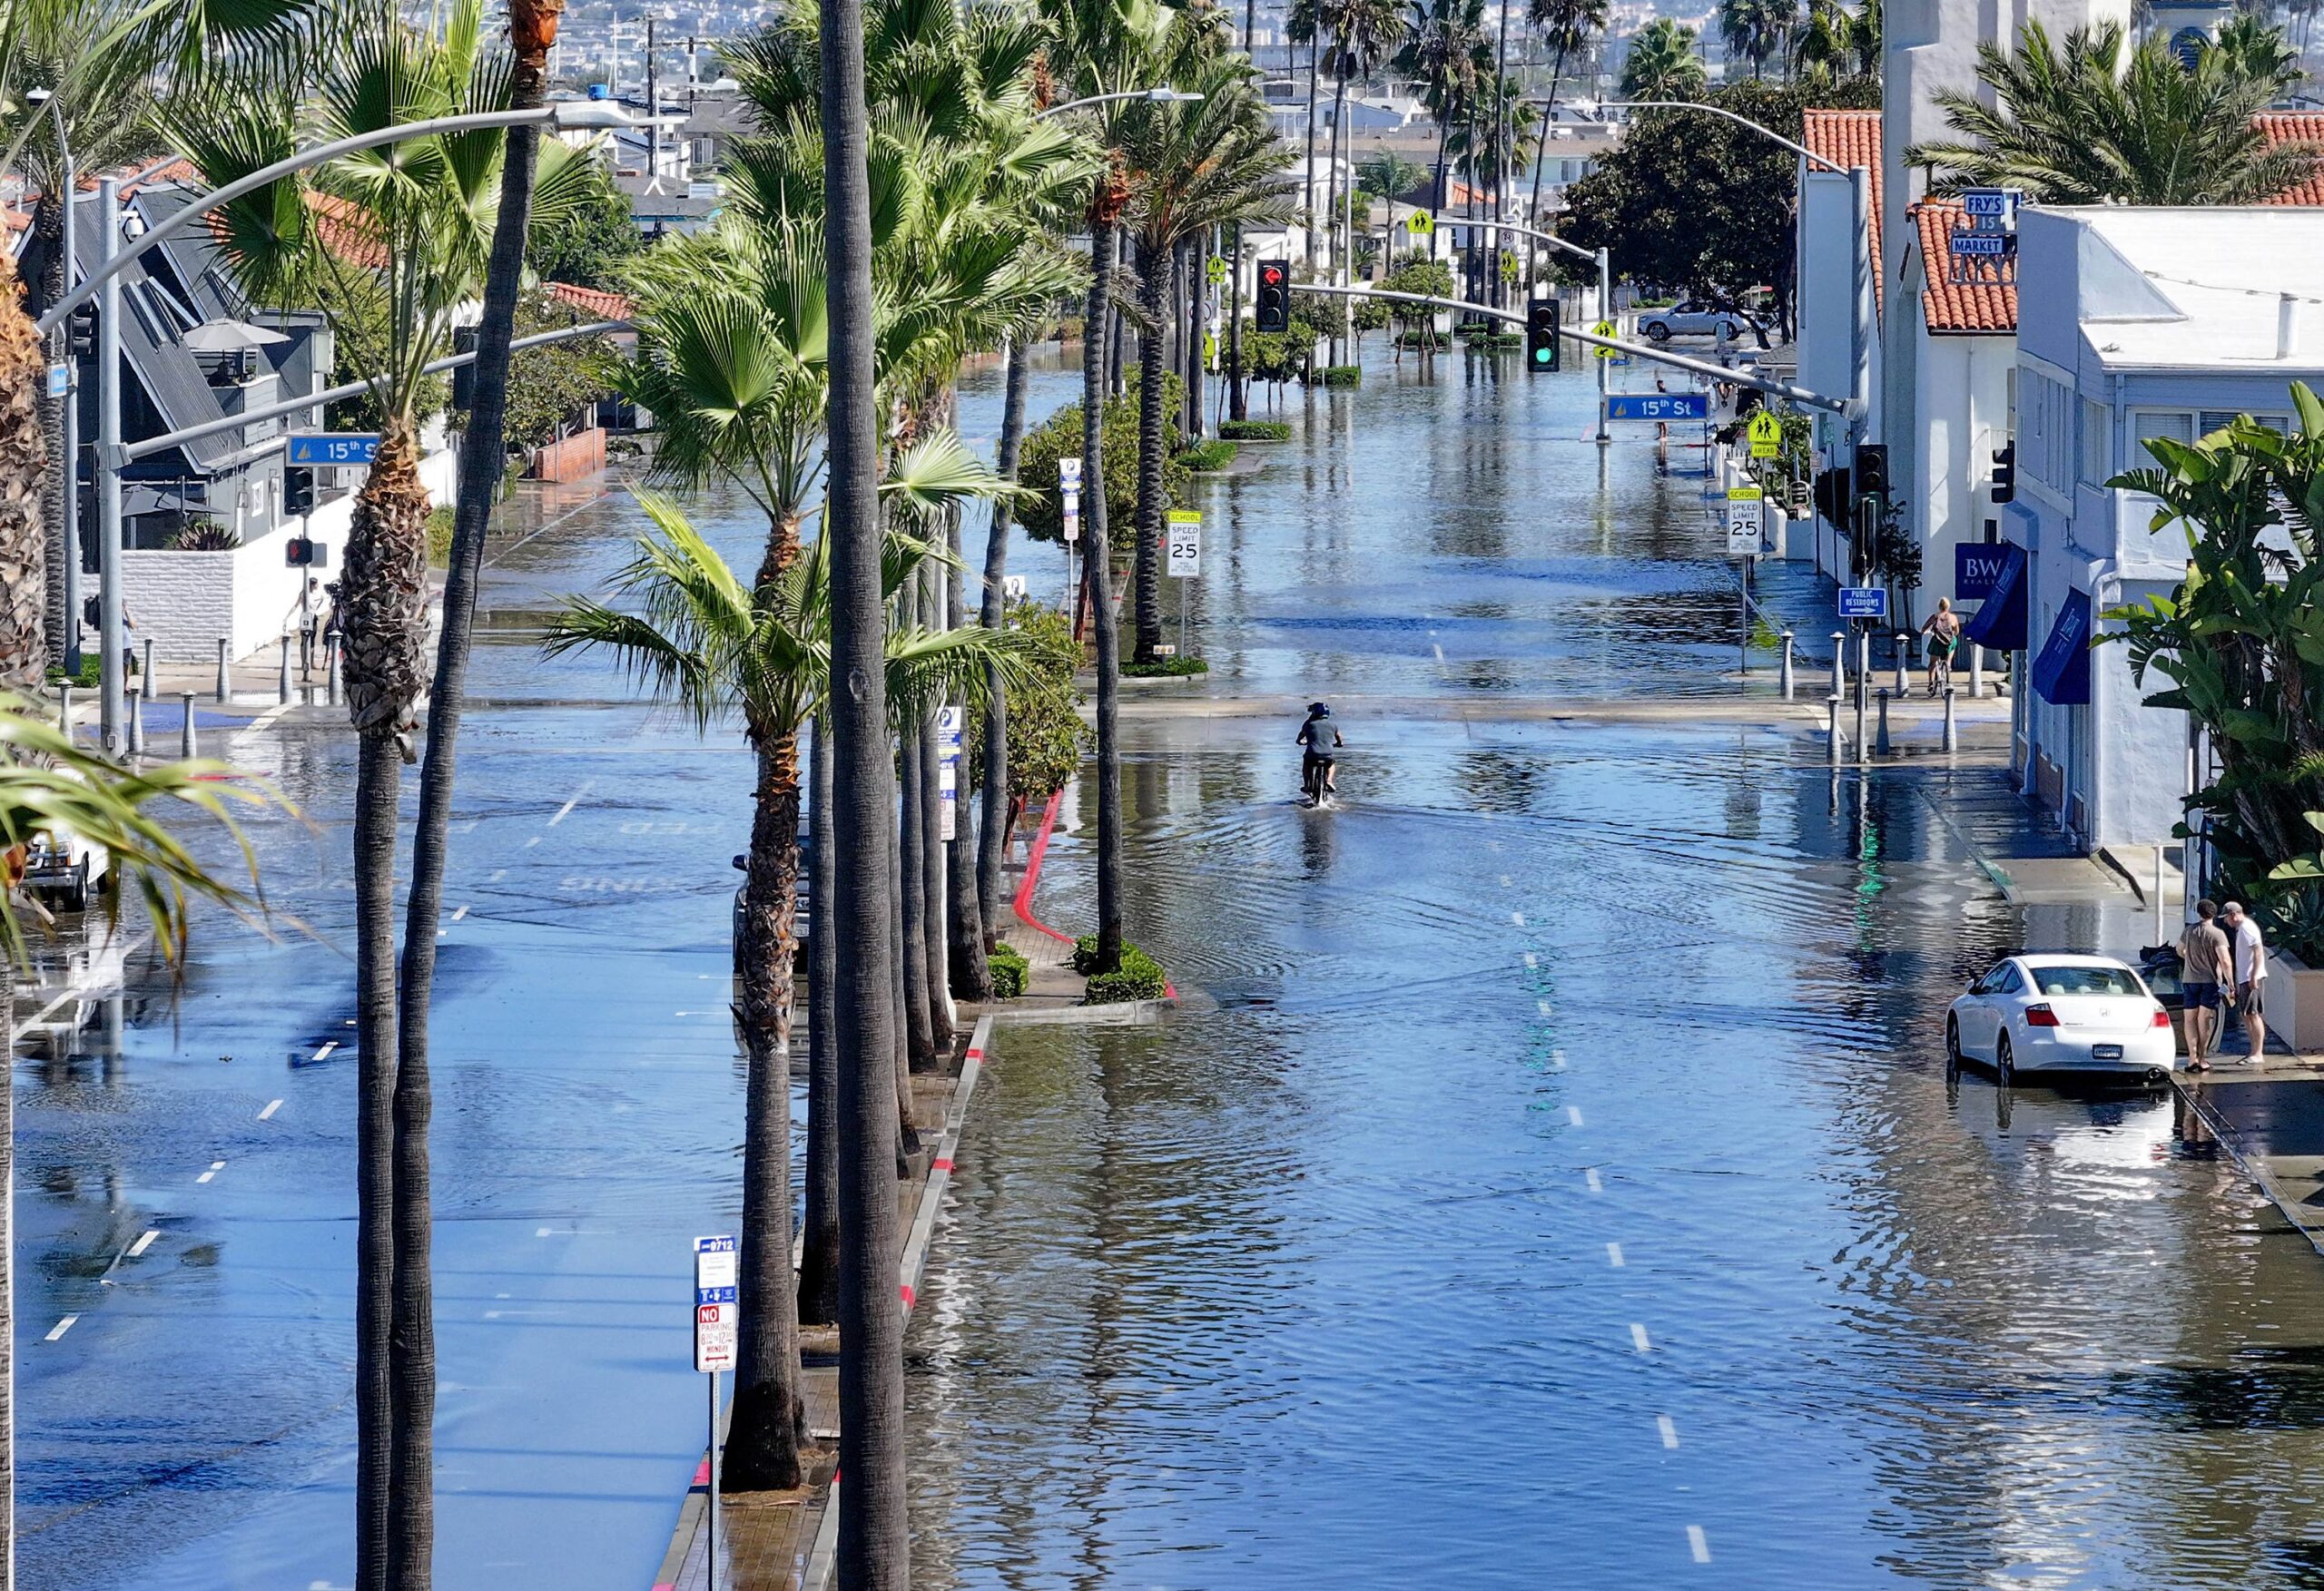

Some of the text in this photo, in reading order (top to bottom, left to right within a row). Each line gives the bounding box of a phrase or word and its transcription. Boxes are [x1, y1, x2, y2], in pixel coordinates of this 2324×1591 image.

[1968, 197, 2002, 211] FRY'S
[1982, 217, 1995, 230] 15
[1955, 240, 2000, 251] MARKET
[1641, 399, 1691, 415] 15th St
[328, 440, 360, 459] 15th
[1171, 514, 1199, 522] SCHOOL
[1731, 521, 1758, 535] 25
[1172, 544, 1197, 558] 25
[1965, 558, 2003, 577] BW
[1852, 590, 1873, 598] PUBLIC
[1846, 599, 1879, 607] RESTROOMS
[710, 1240, 734, 1252] 9712
[701, 1308, 717, 1321] NO
[701, 1322, 733, 1332] PARKING
[707, 1345, 729, 1353] MONDAY
